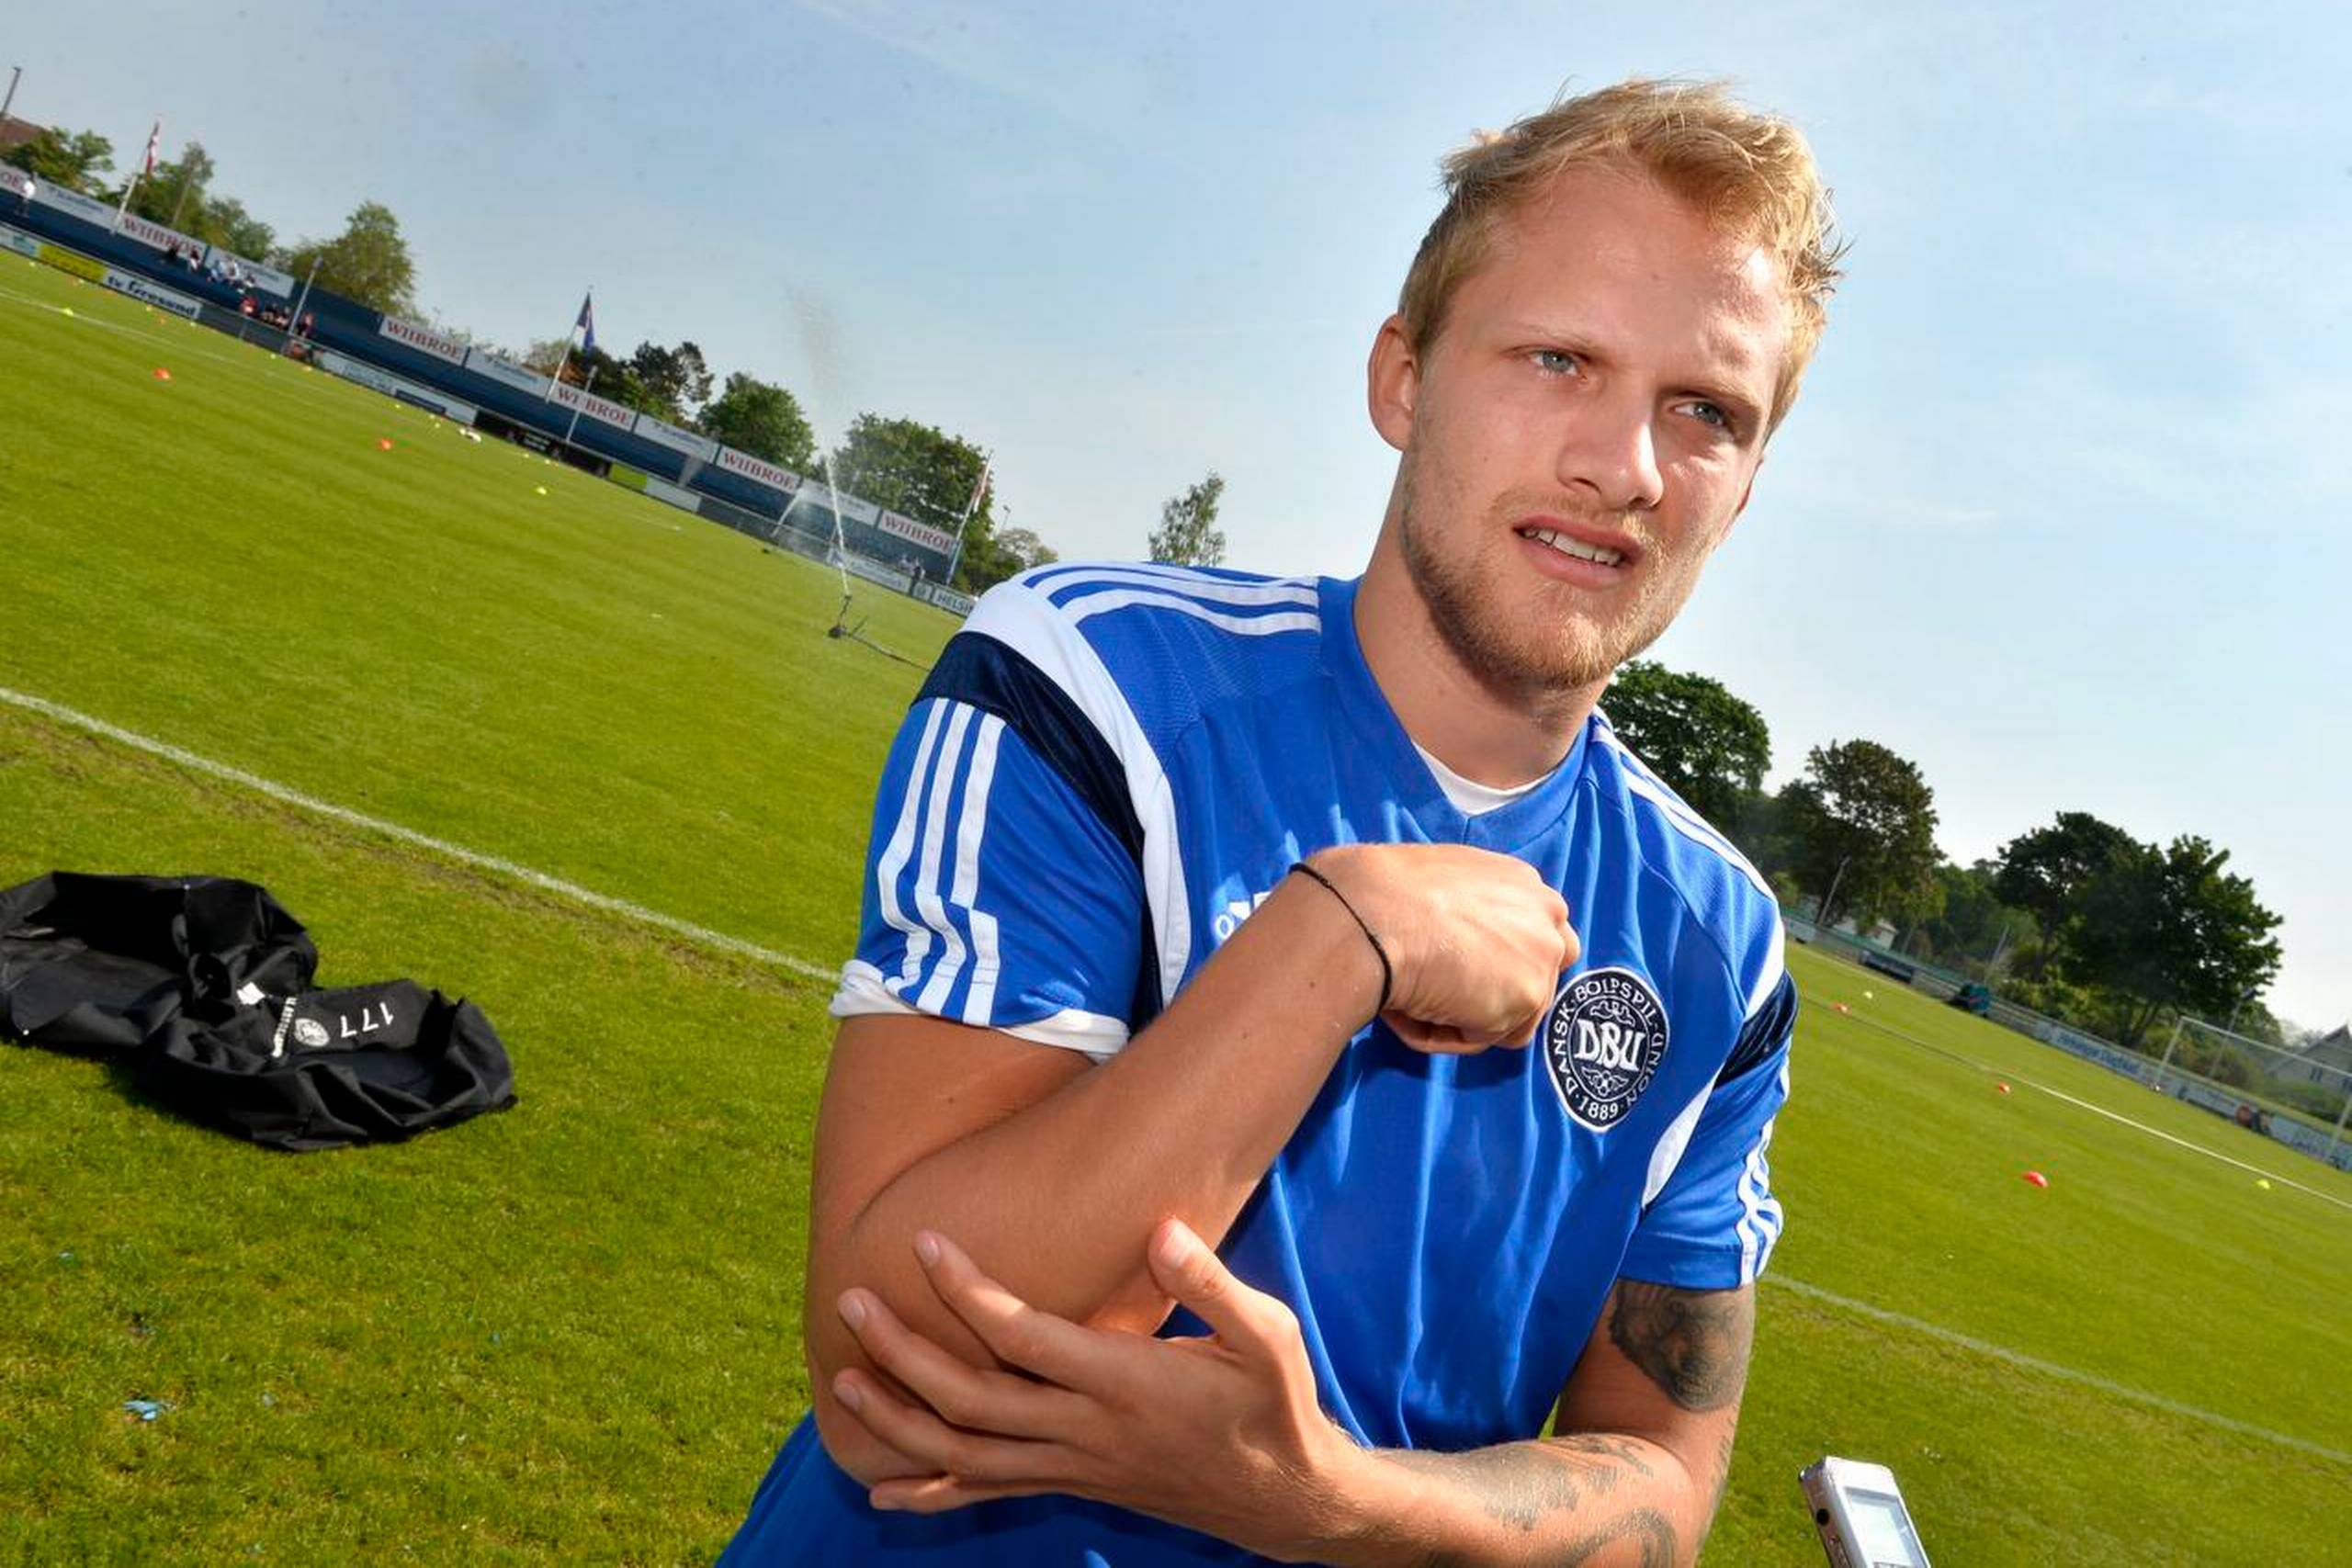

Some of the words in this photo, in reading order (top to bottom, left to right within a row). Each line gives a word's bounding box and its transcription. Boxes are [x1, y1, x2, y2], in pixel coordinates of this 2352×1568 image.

[559, 387, 633, 426] WIBROE
[340, 1001, 394, 1038] 177
[1574, 1019, 1646, 1072] DBU
[1578, 1096, 1619, 1121] 1889
